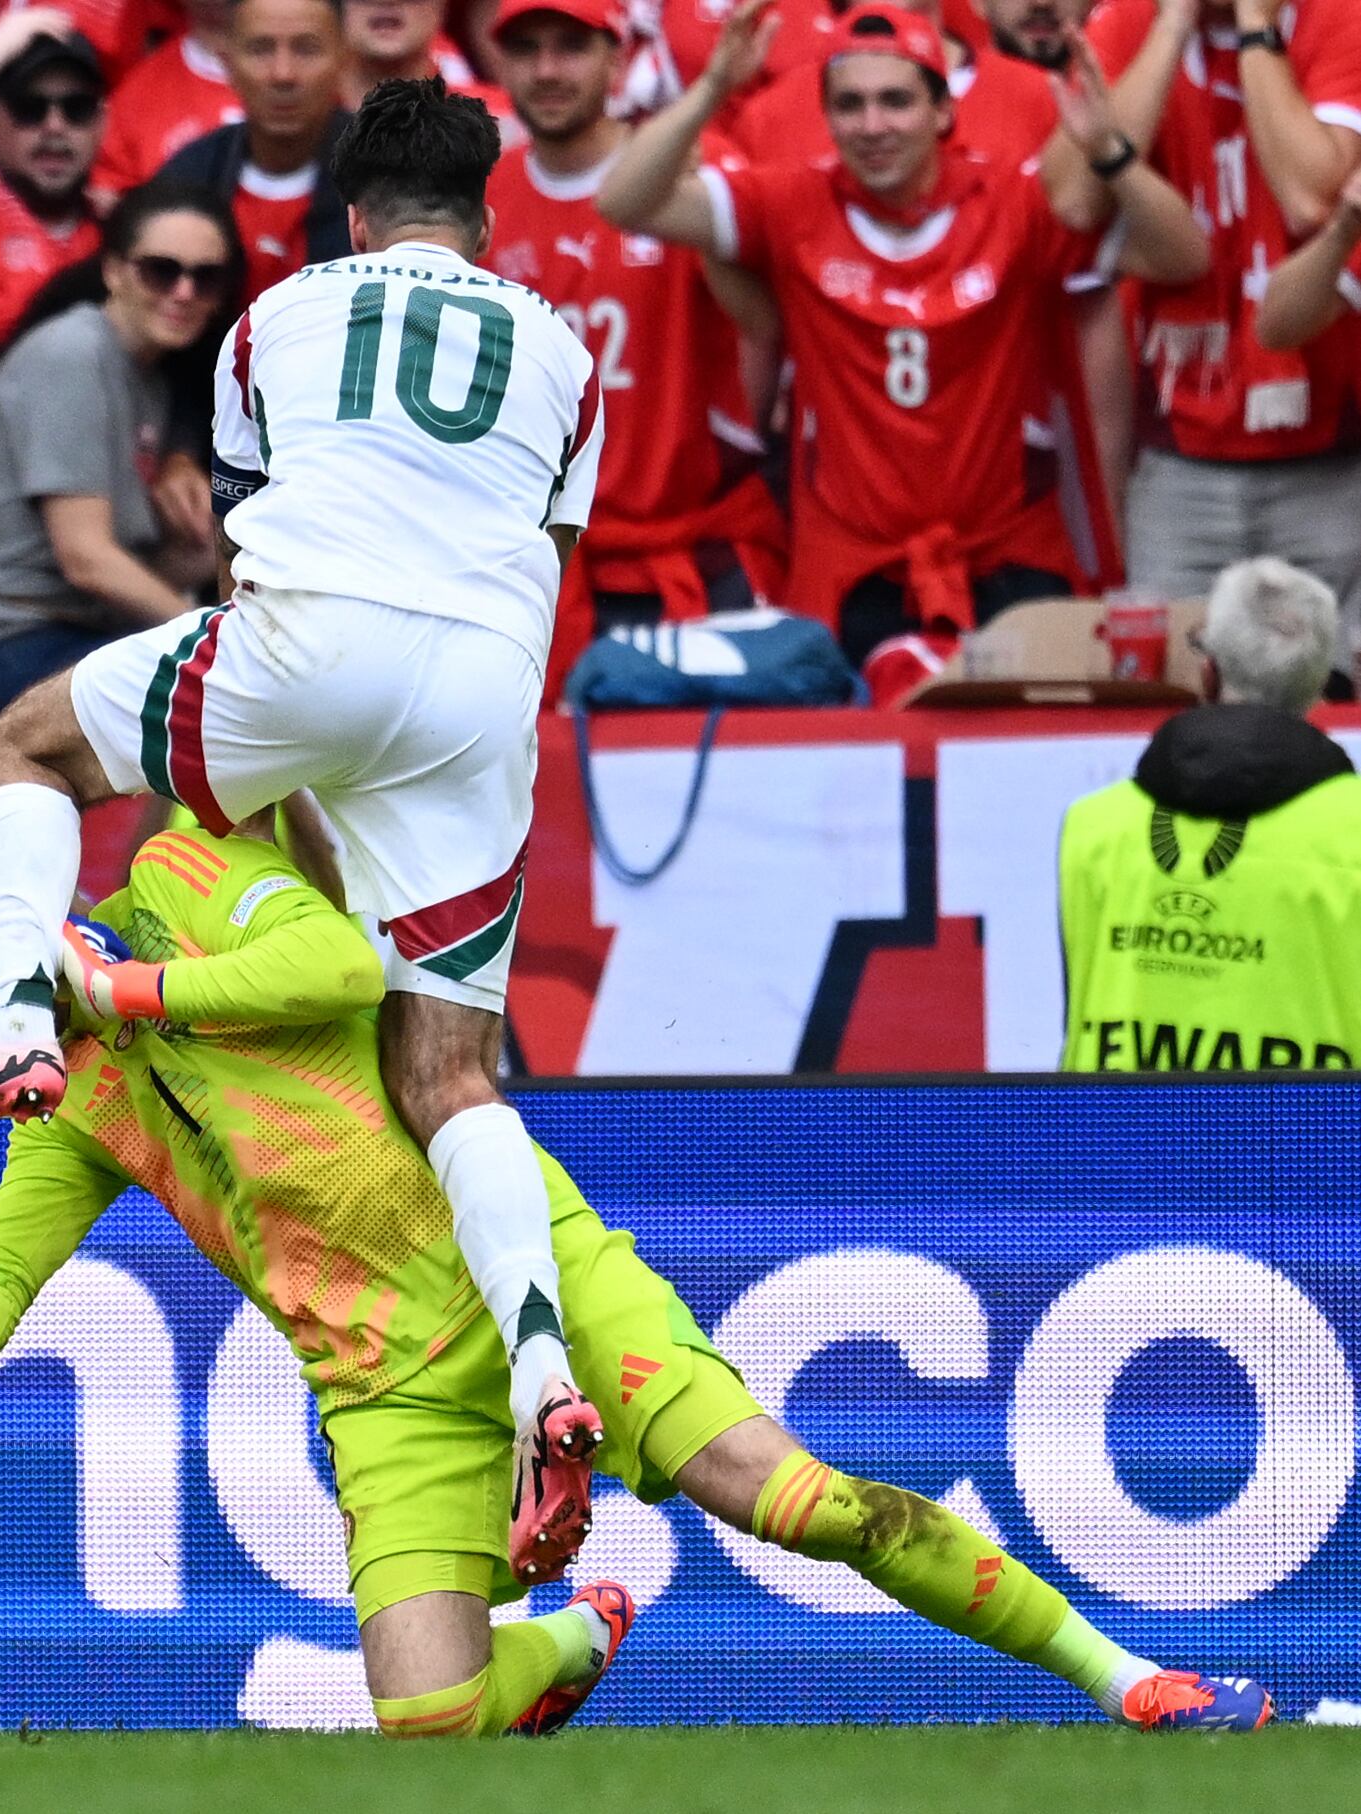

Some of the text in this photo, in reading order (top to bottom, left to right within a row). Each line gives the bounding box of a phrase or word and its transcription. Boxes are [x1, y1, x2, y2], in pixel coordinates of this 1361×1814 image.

[336, 281, 514, 444] 10
[883, 327, 930, 409] 8
[1080, 1019, 1354, 1073] EWARD
